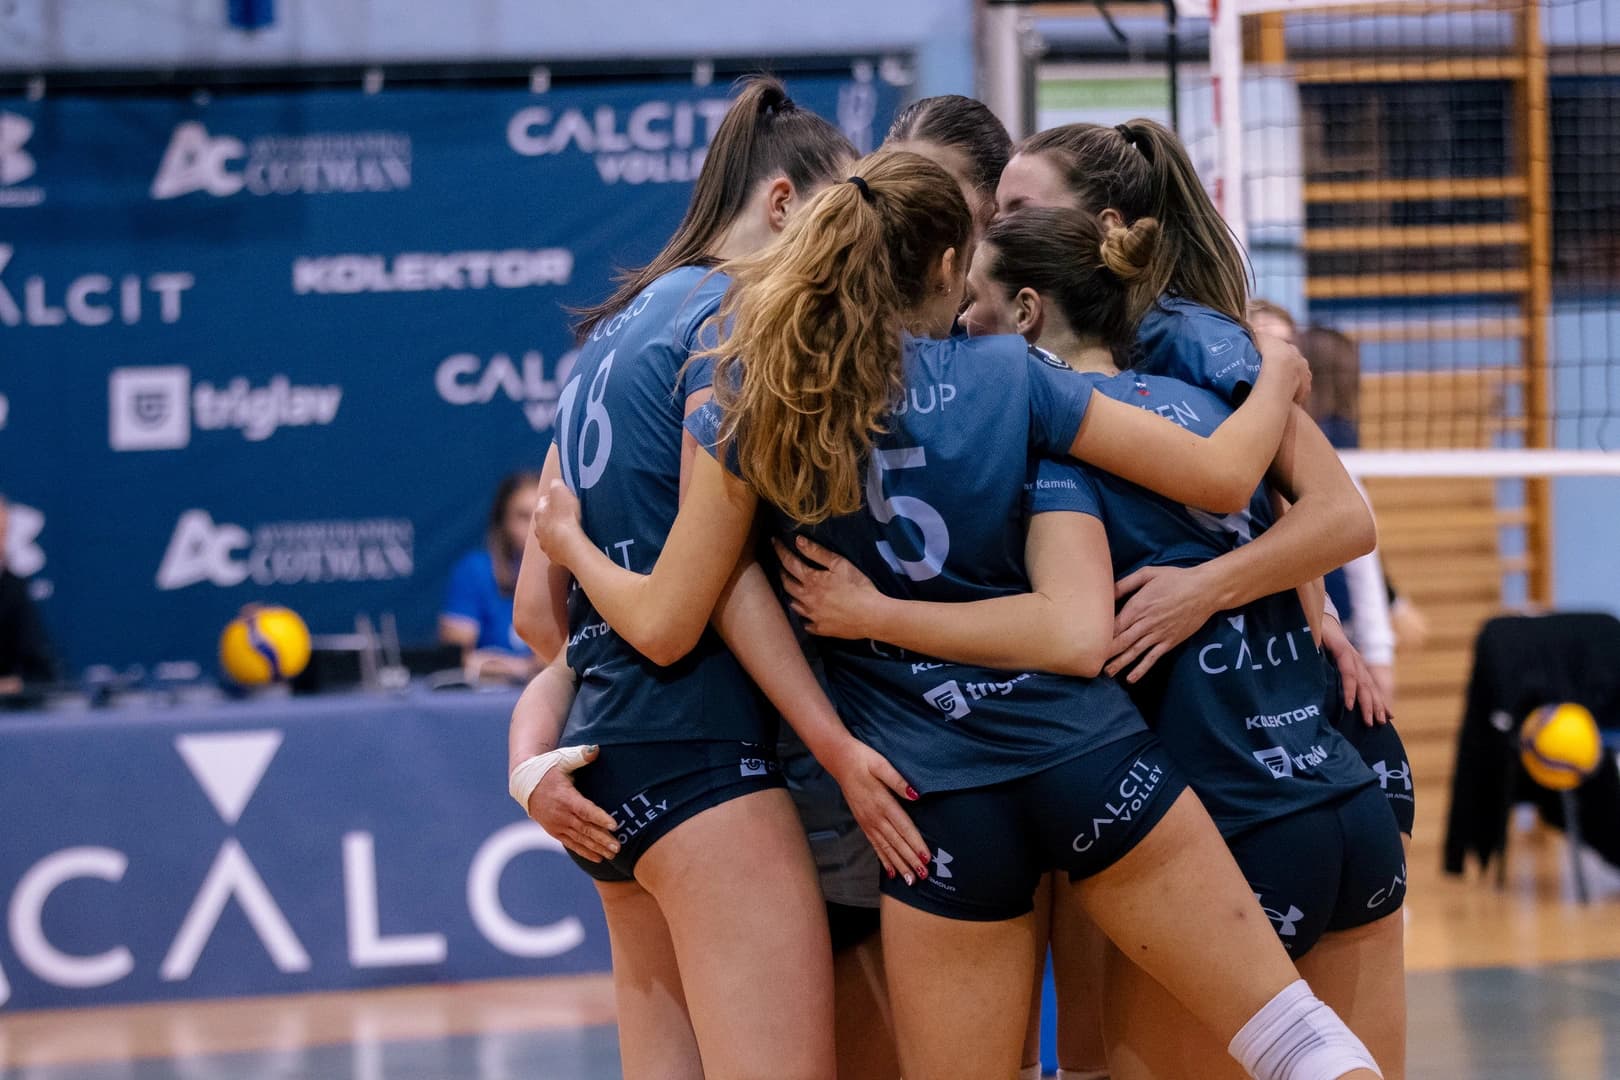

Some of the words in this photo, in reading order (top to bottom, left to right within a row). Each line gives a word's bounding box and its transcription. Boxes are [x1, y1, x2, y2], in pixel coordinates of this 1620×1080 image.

[293, 248, 574, 295] KOLEKTOR
[194, 373, 343, 442] triglav
[553, 348, 614, 498] 18
[867, 446, 951, 582] 5
[1036, 479, 1078, 490] Kamnik
[1072, 757, 1150, 852] CALCIT
[1120, 765, 1163, 821] VOLLEY
[8, 820, 587, 989] CALC
